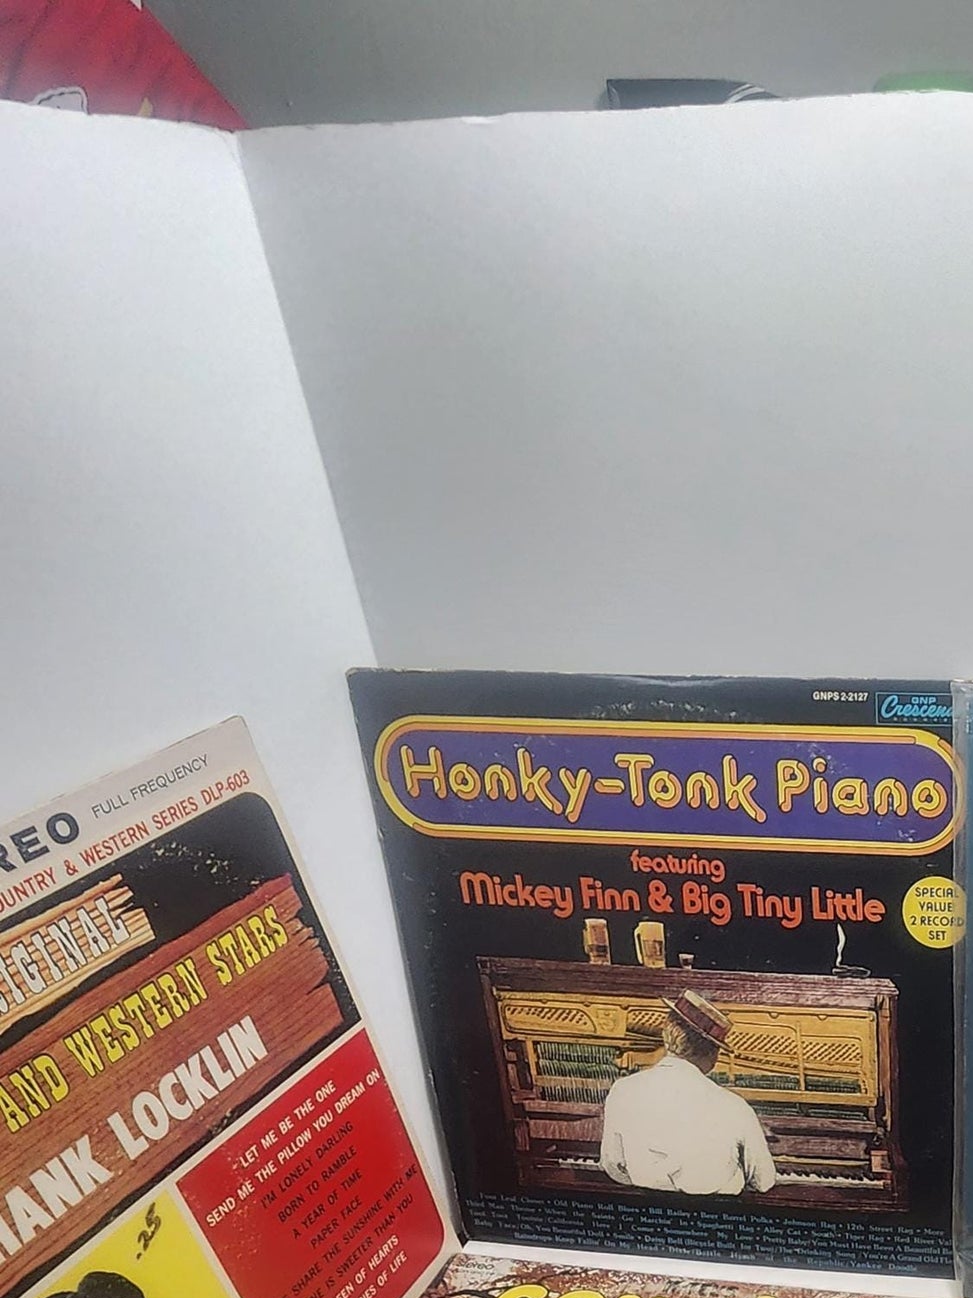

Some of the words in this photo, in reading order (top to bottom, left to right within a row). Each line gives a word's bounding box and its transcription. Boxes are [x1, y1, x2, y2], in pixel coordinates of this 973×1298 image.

[813, 690, 840, 702] GNPS
[840, 691, 869, 702] 2-2127
[911, 696, 937, 705] GNP
[91, 796, 129, 819] FULL
[130, 754, 209, 808] FREQUENCY
[400, 744, 767, 823] Honky-Tonk
[775, 756, 949, 818] Piano
[0, 867, 57, 912] OUNTRY
[64, 860, 78, 876] &
[79, 825, 151, 868] WESTERN
[152, 796, 199, 837] SERIES
[200, 769, 250, 808] DLP-603
[630, 850, 726, 882] featuring
[460, 870, 574, 916] Mickey
[581, 876, 643, 912] Finn
[647, 882, 674, 915] &
[682, 883, 731, 926] Big
[736, 884, 805, 927] Tiny
[811, 886, 887, 922] Little
[915, 887, 959, 898] SPECIAL
[918, 901, 953, 912] VALUE
[910, 915, 918, 926] 2
[920, 916, 964, 927] RECORD
[928, 930, 947, 941] SET
[0, 895, 130, 1013] IGINAL
[0, 1053, 70, 1134] AND
[63, 957, 209, 1078] WESTERN
[205, 904, 289, 987] STARS
[107, 1015, 268, 1161] LOCKLIN
[206, 1197, 236, 1227] SEND
[236, 1180, 256, 1201] ME
[255, 1160, 278, 1184] THE
[277, 1128, 313, 1165] PILLOW
[313, 1110, 333, 1133] YOU
[334, 1082, 366, 1115] DREAM
[366, 1068, 381, 1086] ON
[239, 1145, 260, 1169] LET
[261, 1130, 279, 1150] ME
[278, 1116, 295, 1135] BE
[294, 1098, 315, 1121] THE
[315, 1080, 337, 1103] ONE
[354, 1267, 368, 1285] OF
[368, 1234, 400, 1271] HEARTS
[376, 1270, 390, 1287] OF
[389, 1250, 408, 1274] LIFE
